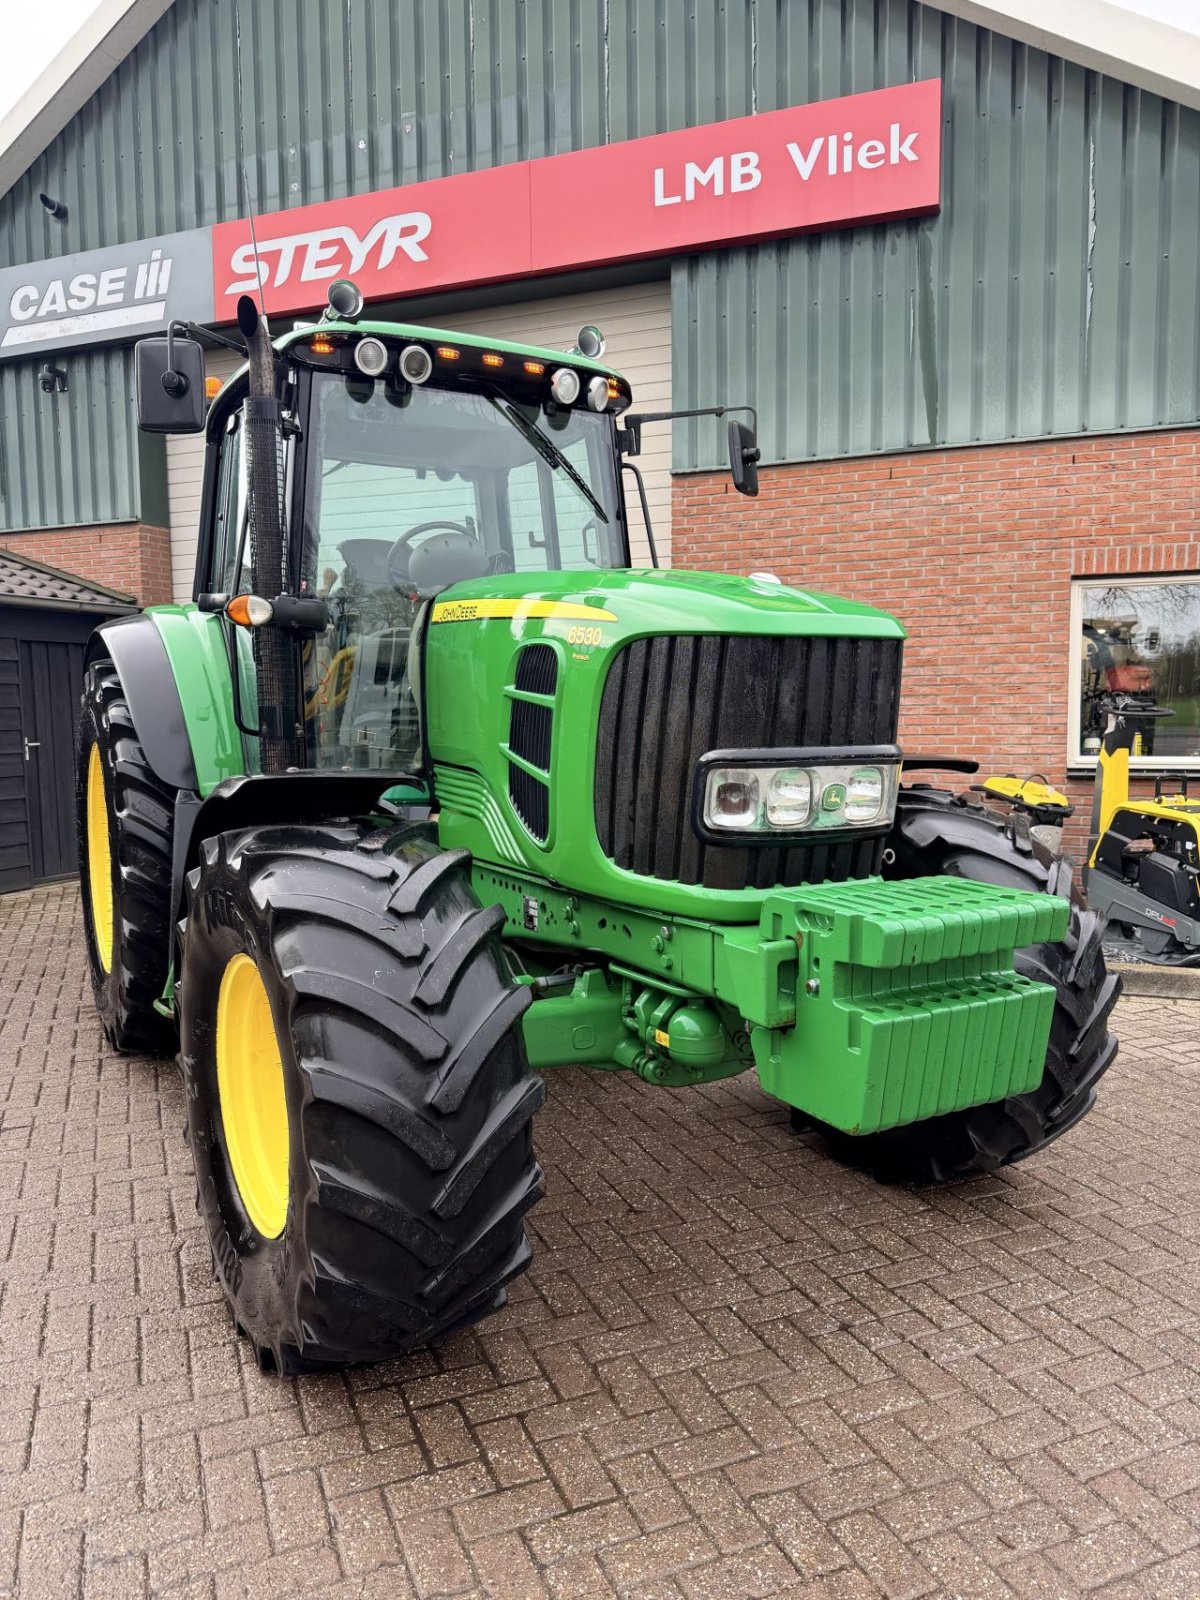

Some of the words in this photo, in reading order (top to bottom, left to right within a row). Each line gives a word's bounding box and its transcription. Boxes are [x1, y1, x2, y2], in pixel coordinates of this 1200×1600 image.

[654, 151, 762, 207] LMB
[786, 122, 919, 181] Vliek
[224, 211, 432, 295] STEYR
[9, 266, 128, 321] CASE
[567, 626, 603, 646] 6530
